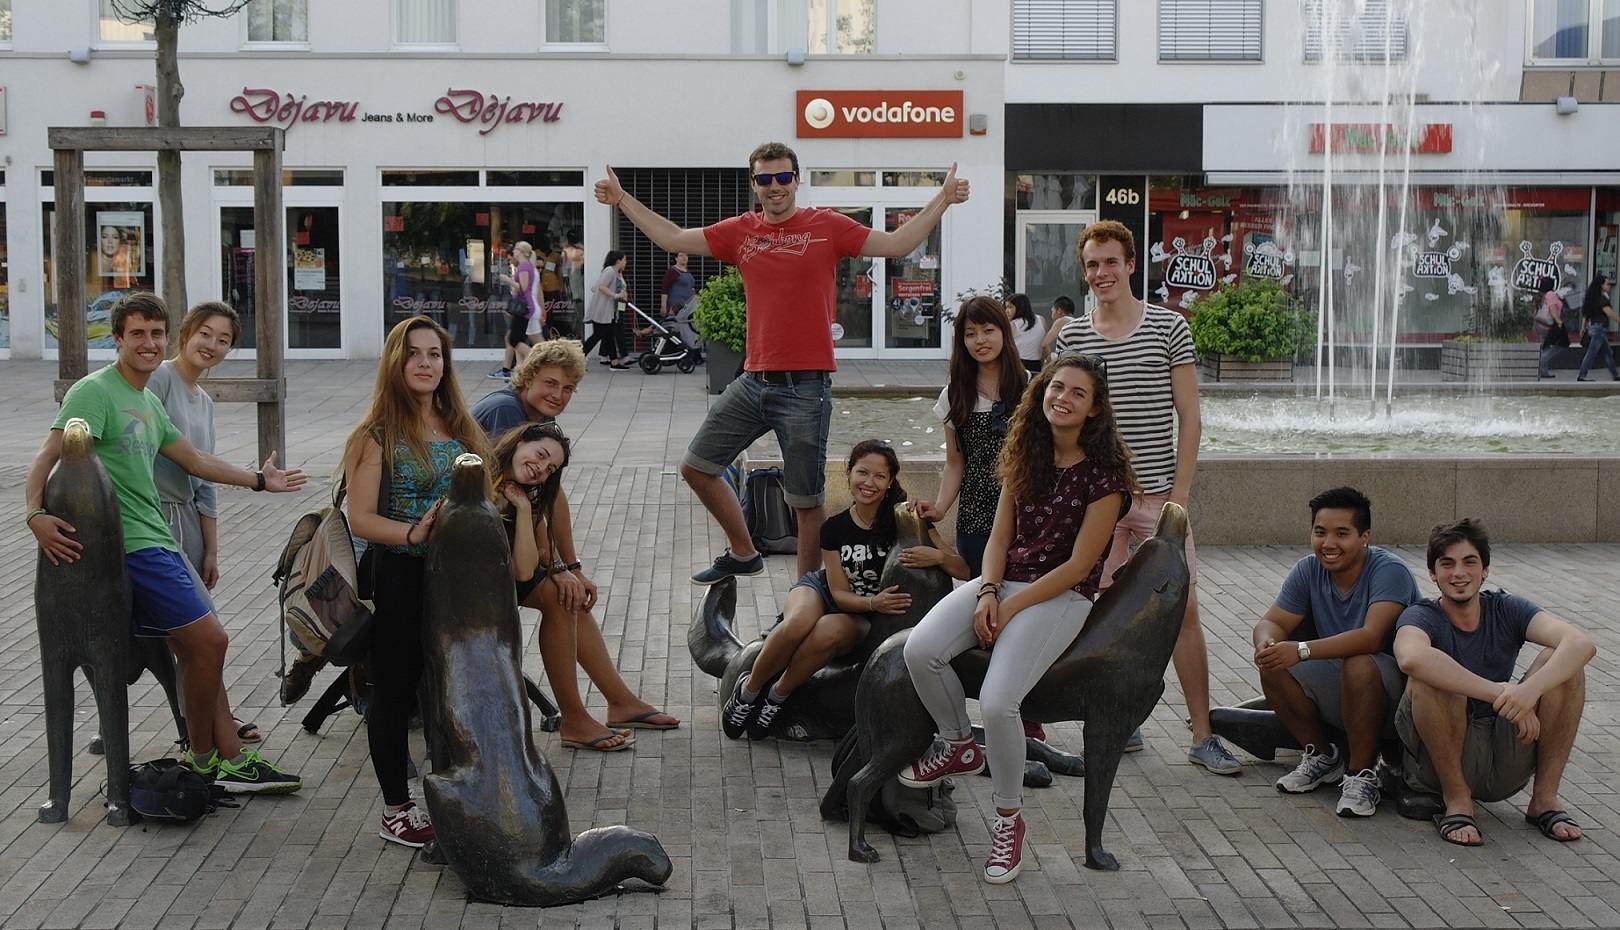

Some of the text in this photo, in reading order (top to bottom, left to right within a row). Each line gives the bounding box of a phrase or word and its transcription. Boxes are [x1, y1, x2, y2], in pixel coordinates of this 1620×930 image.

[362, 112, 393, 123] Jeans
[396, 112, 405, 123] &
[407, 112, 434, 123] More
[841, 101, 955, 124] vodafone
[1105, 188, 1140, 205] 46b
[1175, 257, 1212, 274] SCHUL
[1254, 254, 1281, 267] SCHUL
[1419, 254, 1447, 265] SCHUL
[1520, 260, 1557, 279] SCHUL
[459, 296, 508, 313] Dejav
[391, 821, 406, 836] N
